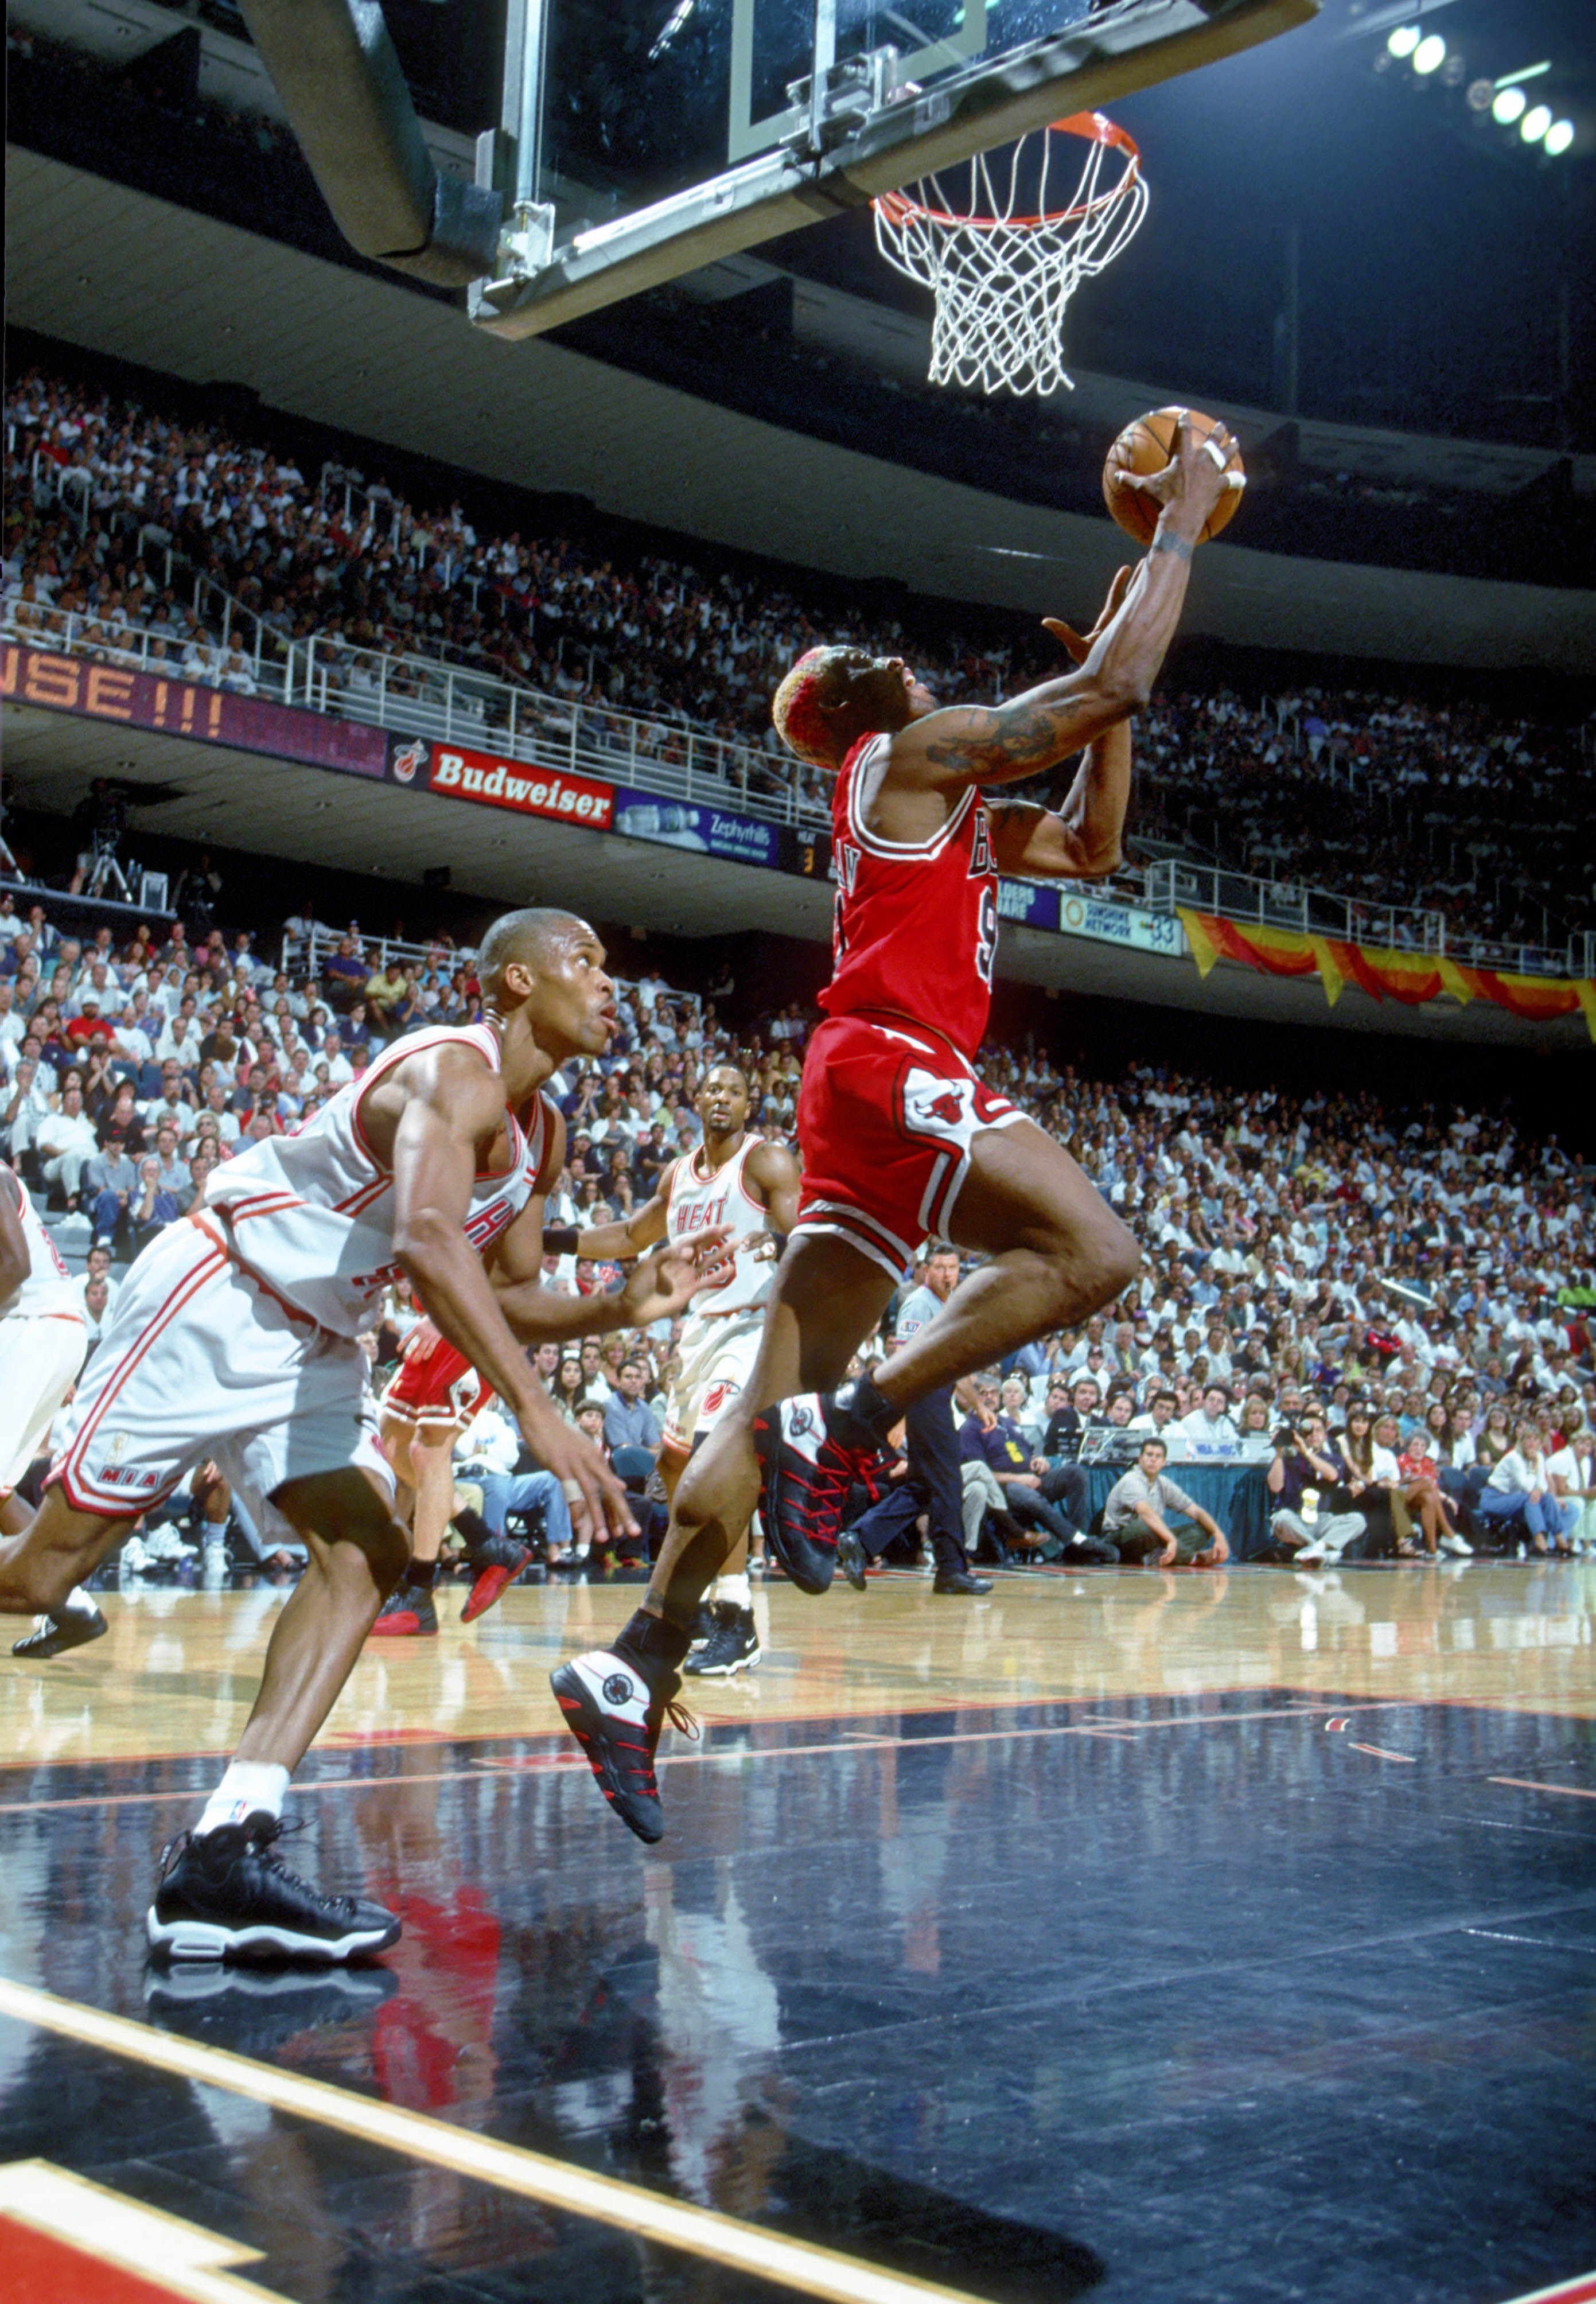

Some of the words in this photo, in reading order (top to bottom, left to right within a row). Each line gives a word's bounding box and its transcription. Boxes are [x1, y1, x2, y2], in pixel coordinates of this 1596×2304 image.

[433, 753, 610, 820] Budweiser
[710, 813, 771, 846] Zephyrhills
[1085, 918, 1131, 937] NETWORK
[676, 1184, 731, 1233] HEAT
